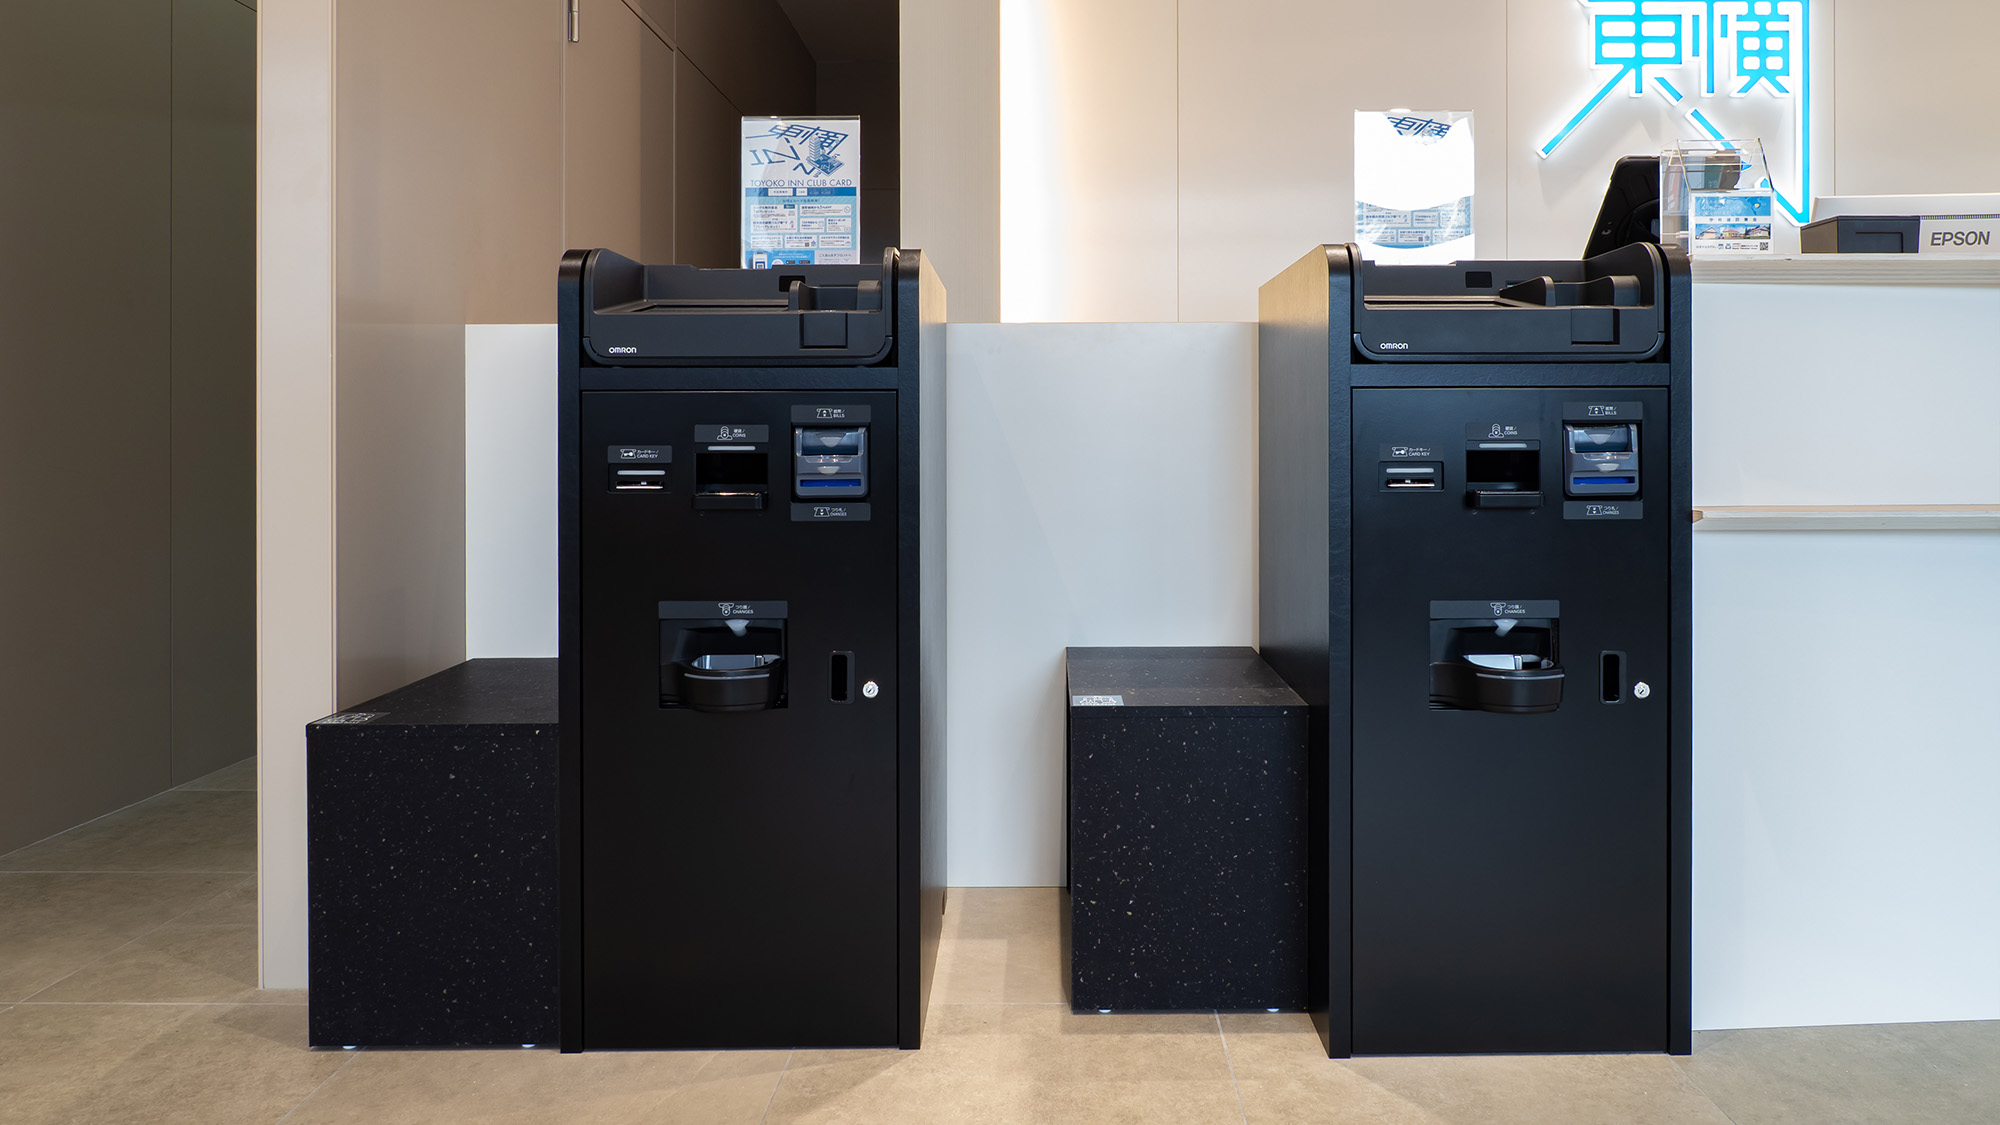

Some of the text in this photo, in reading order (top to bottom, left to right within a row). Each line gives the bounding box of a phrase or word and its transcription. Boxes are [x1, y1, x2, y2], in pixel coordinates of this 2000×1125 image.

[787, 179, 804, 187] INN
[807, 179, 827, 187] CLUB
[829, 179, 852, 187] CARD
[1930, 231, 1990, 246] EPSON
[609, 346, 637, 354] OMRON
[1380, 342, 1409, 350] OMRON
